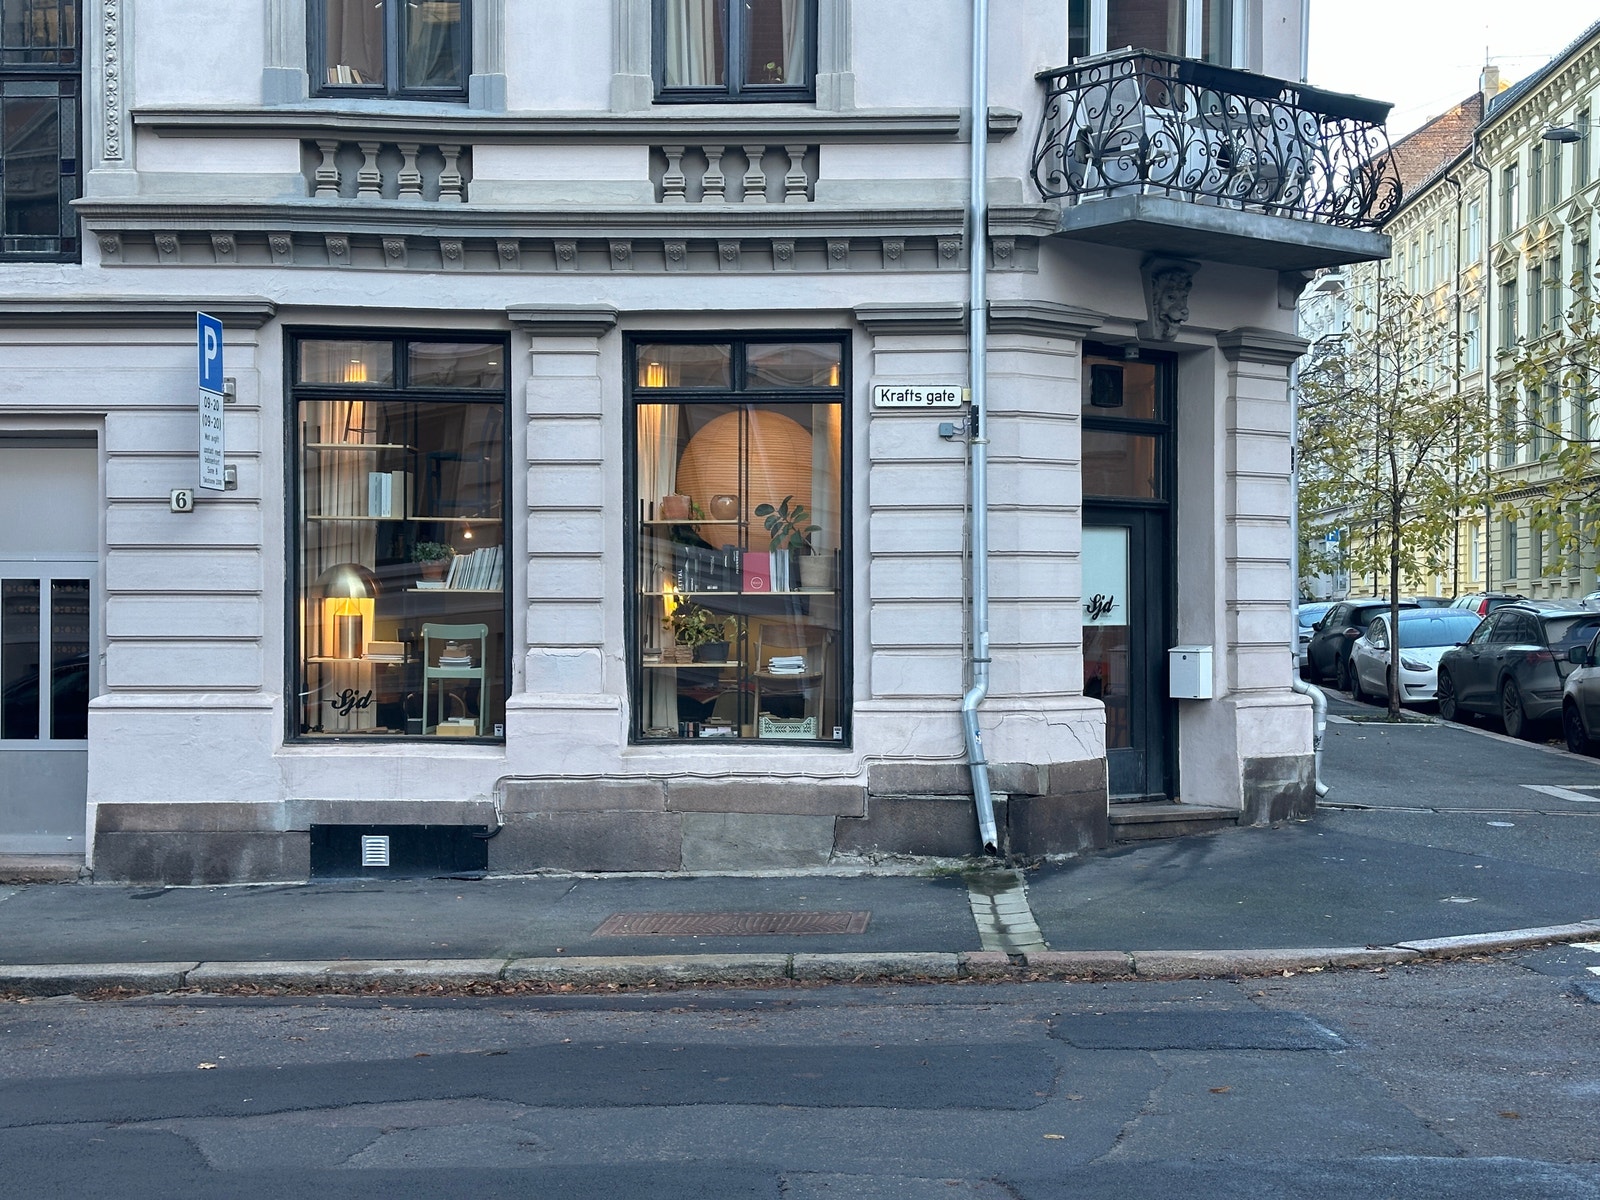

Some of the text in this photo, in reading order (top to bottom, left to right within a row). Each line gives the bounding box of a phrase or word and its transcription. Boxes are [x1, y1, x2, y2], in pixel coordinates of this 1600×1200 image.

[204, 325, 218, 380] P
[204, 396, 220, 411] 09-20
[881, 388, 955, 405] Krafts gate
[202, 413, 222, 431] (09-20)
[175, 491, 187, 509] 6
